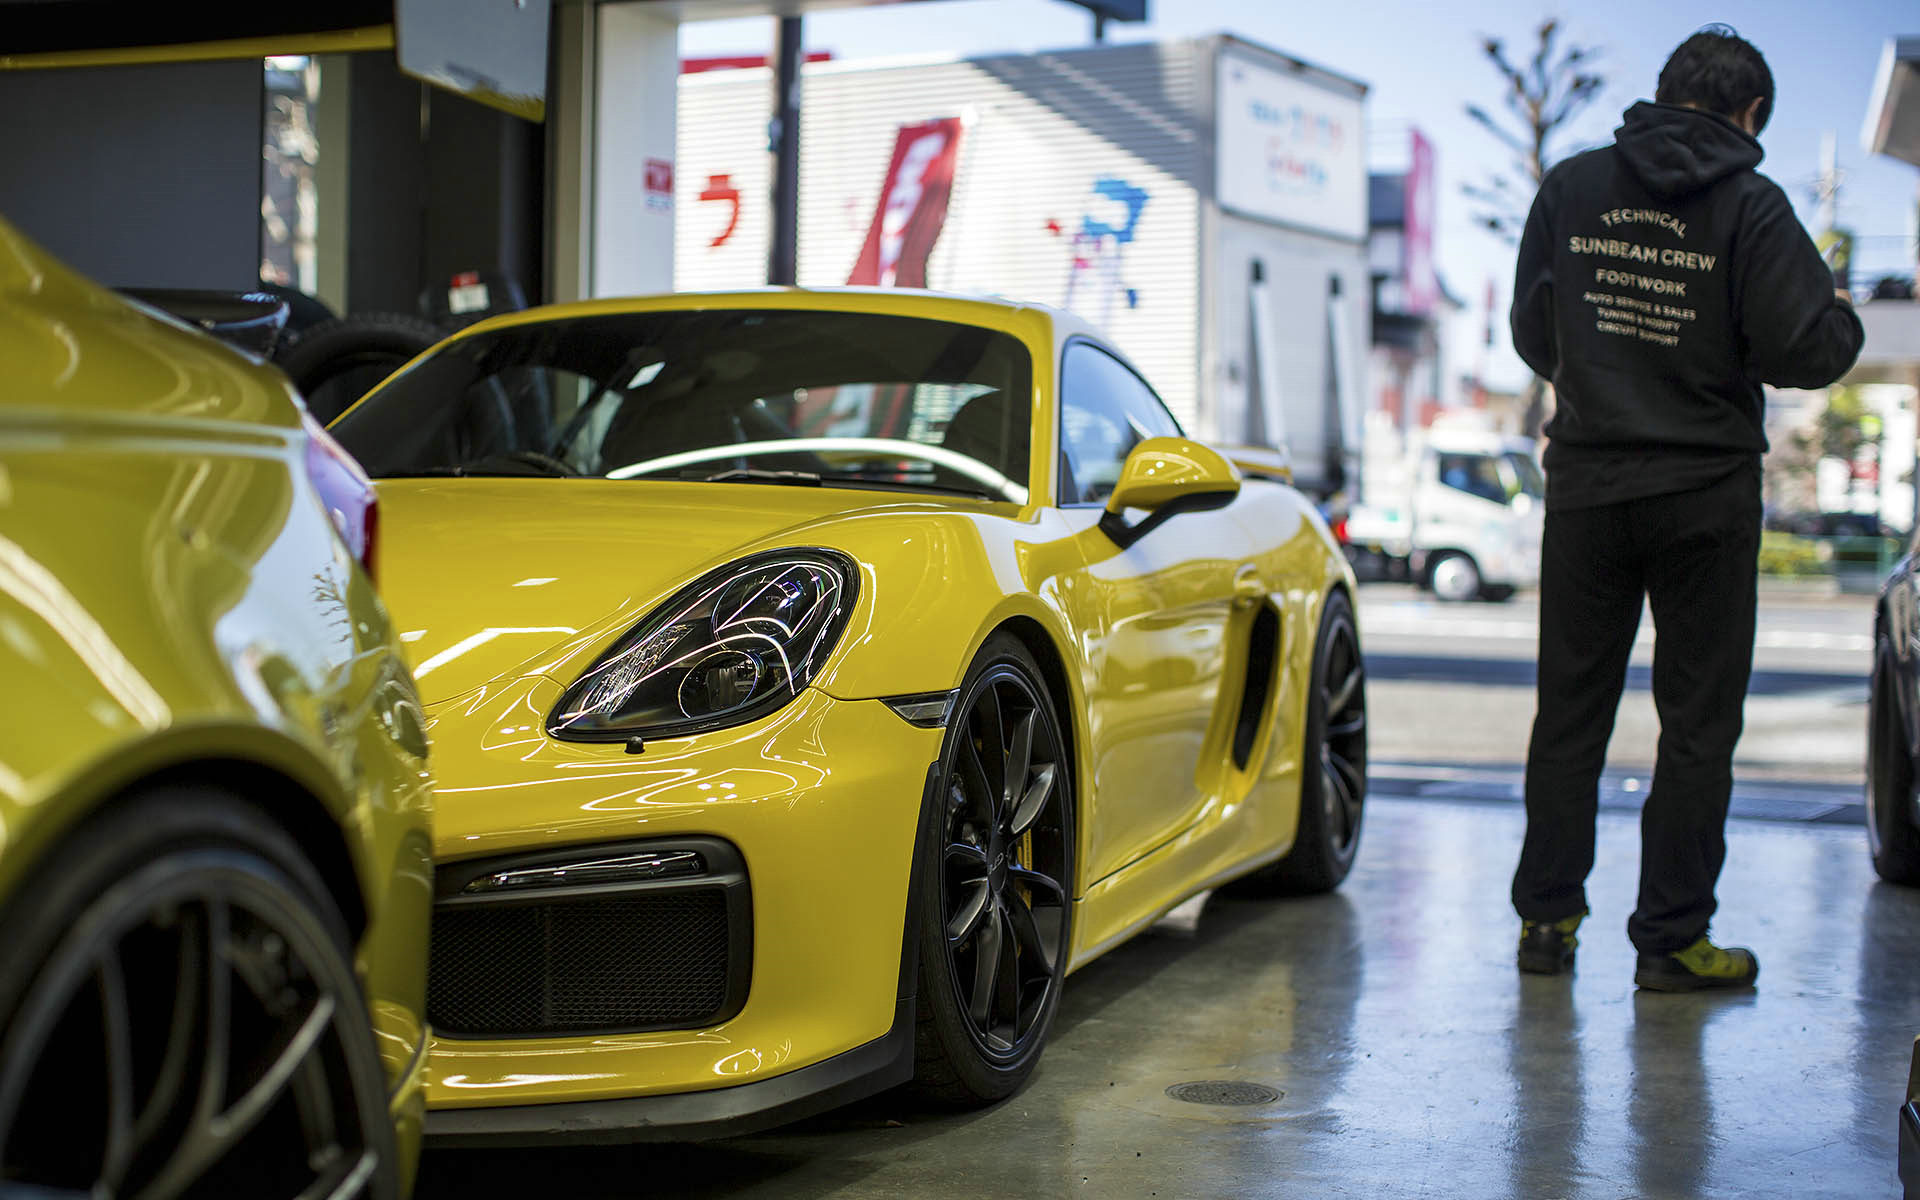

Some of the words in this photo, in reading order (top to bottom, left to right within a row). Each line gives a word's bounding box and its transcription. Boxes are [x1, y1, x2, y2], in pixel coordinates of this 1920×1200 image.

[1600, 208, 1687, 239] TECHNICAL
[1569, 236, 1658, 263] SUNBEAM
[1661, 249, 1716, 272] CREW
[1595, 268, 1687, 297] FOOTWORK
[1583, 291, 1614, 305] AUTO
[1662, 305, 1697, 321] SALES
